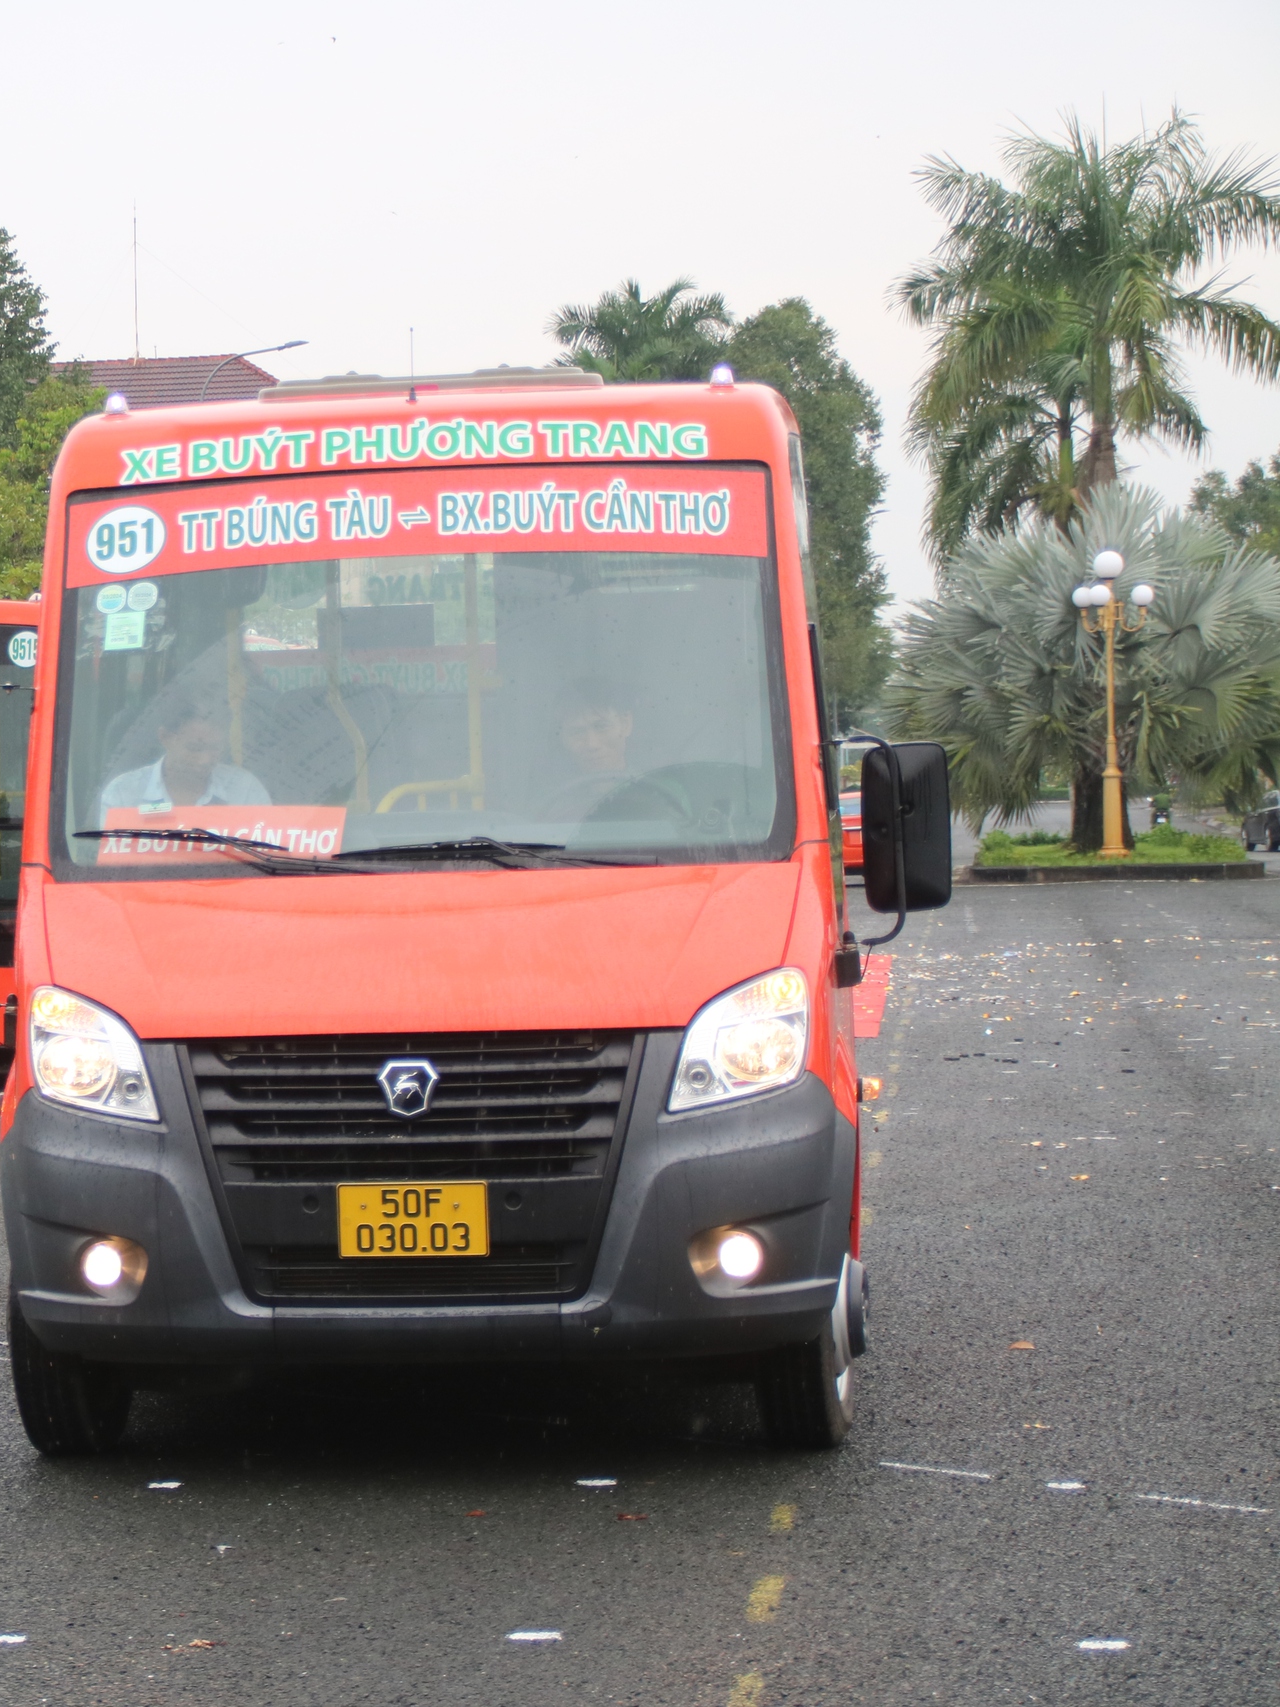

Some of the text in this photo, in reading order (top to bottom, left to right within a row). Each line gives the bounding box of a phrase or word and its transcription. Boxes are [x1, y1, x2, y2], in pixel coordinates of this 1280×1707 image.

[120, 417, 708, 486] XE BUÝT PHƯƠNG TRANG
[179, 478, 731, 553] TT BÚNG TÀU BX.BUÝT CẦN THƠ
[95, 518, 155, 561] 951
[287, 828, 337, 853] THƠ
[380, 1188, 442, 1217] 50F
[356, 1223, 470, 1252] 030.03
